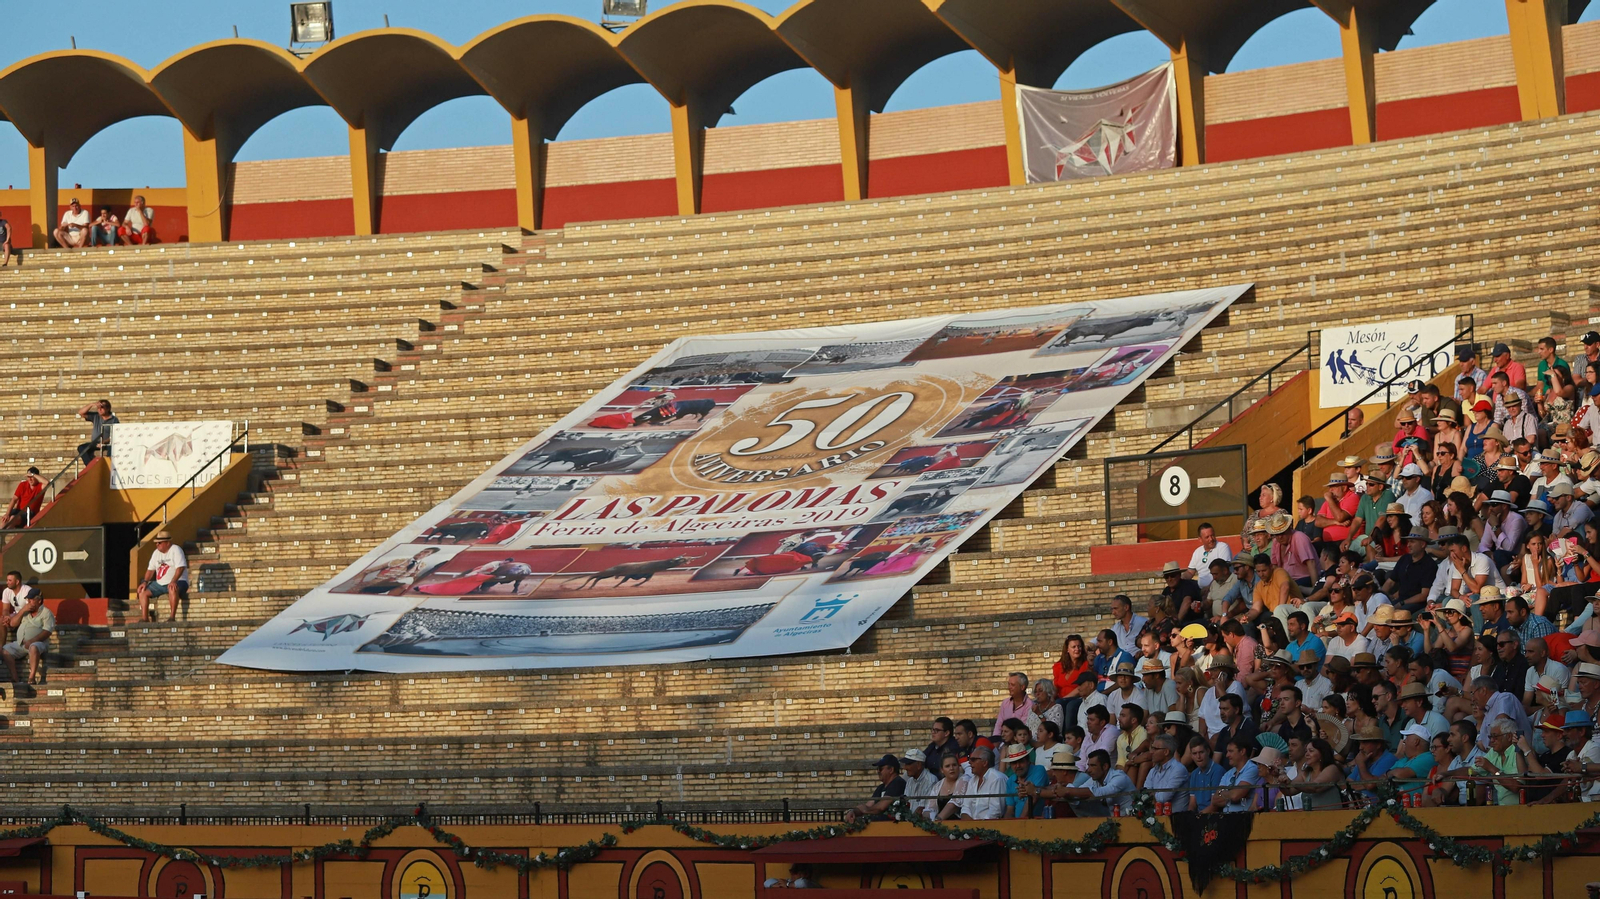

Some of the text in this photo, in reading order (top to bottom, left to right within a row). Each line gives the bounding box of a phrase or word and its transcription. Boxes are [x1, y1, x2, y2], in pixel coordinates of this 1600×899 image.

[1346, 328, 1386, 345] Mesón
[1396, 333, 1419, 353] el
[1379, 351, 1450, 380] COPO
[729, 391, 914, 456] 50
[694, 440, 886, 483] ANIVERSARIO
[111, 474, 161, 486] LANCES
[1169, 474, 1181, 496] 8
[550, 481, 901, 521] LAS PALOMAS
[532, 506, 870, 536] Feria de Algeciras 2019
[32, 547, 54, 565] 10
[773, 623, 832, 634] Ayuntamiento
[783, 629, 822, 637] Algeciras
